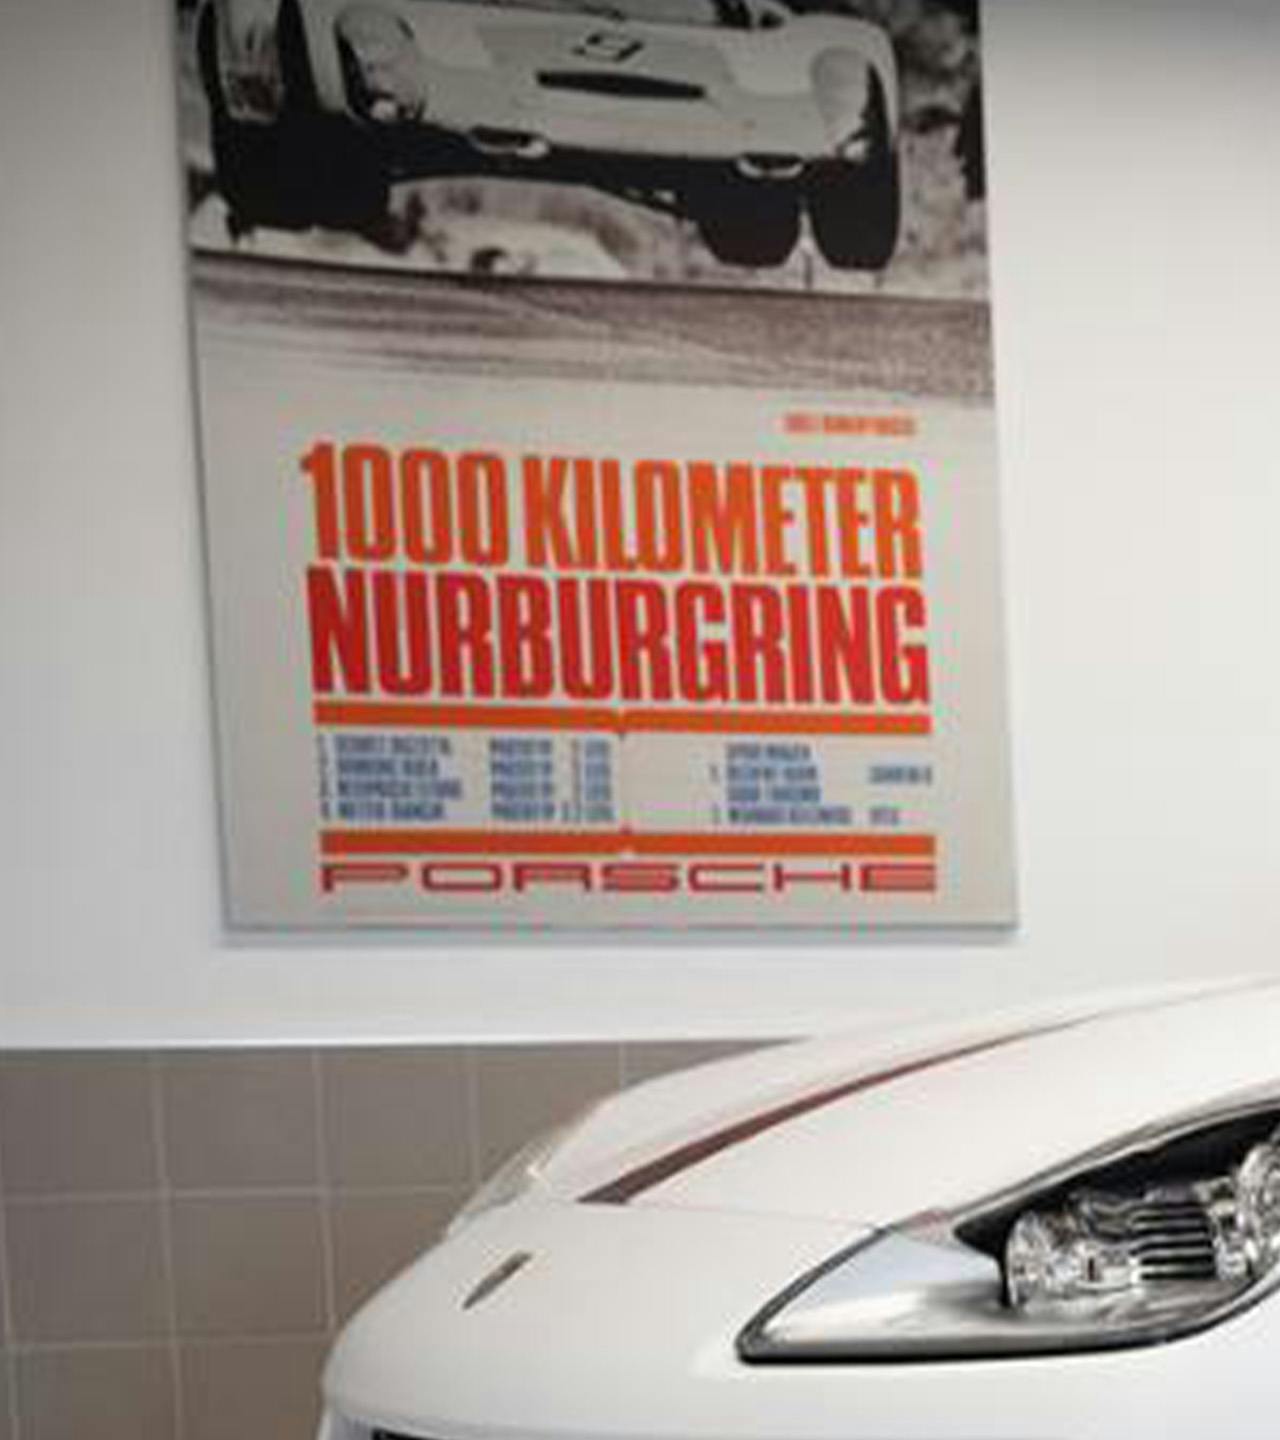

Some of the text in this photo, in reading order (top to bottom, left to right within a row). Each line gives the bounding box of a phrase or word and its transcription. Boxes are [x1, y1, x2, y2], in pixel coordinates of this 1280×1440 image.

[300, 442, 924, 580] 1000 KILOMETER
[305, 565, 931, 704] NURBURGRING
[320, 861, 938, 894] PORSCHE
